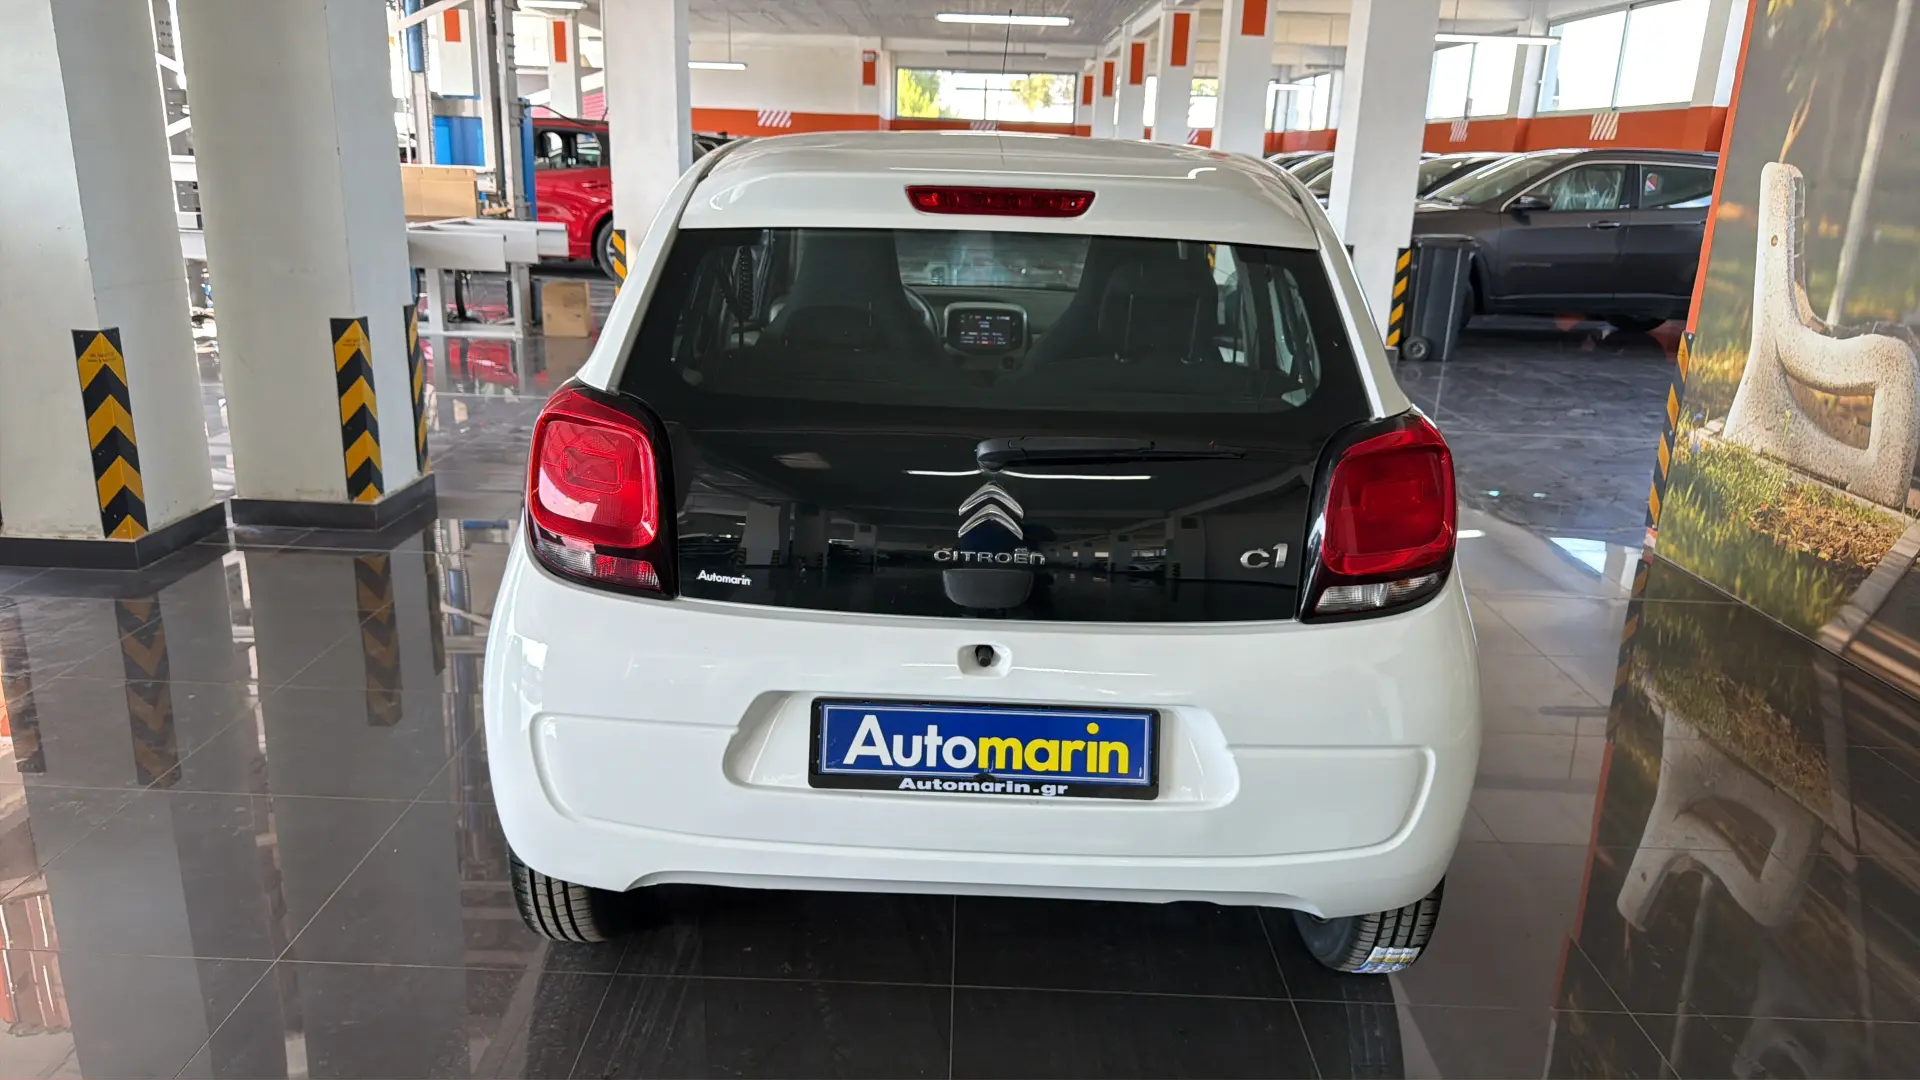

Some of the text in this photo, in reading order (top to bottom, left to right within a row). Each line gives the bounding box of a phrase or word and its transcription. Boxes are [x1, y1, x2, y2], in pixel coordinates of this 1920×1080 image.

[1240, 543, 1288, 569] C1
[696, 569, 752, 586] Automarin
[842, 714, 1130, 775] Automarin
[898, 777, 1069, 797] Automarin.gr
